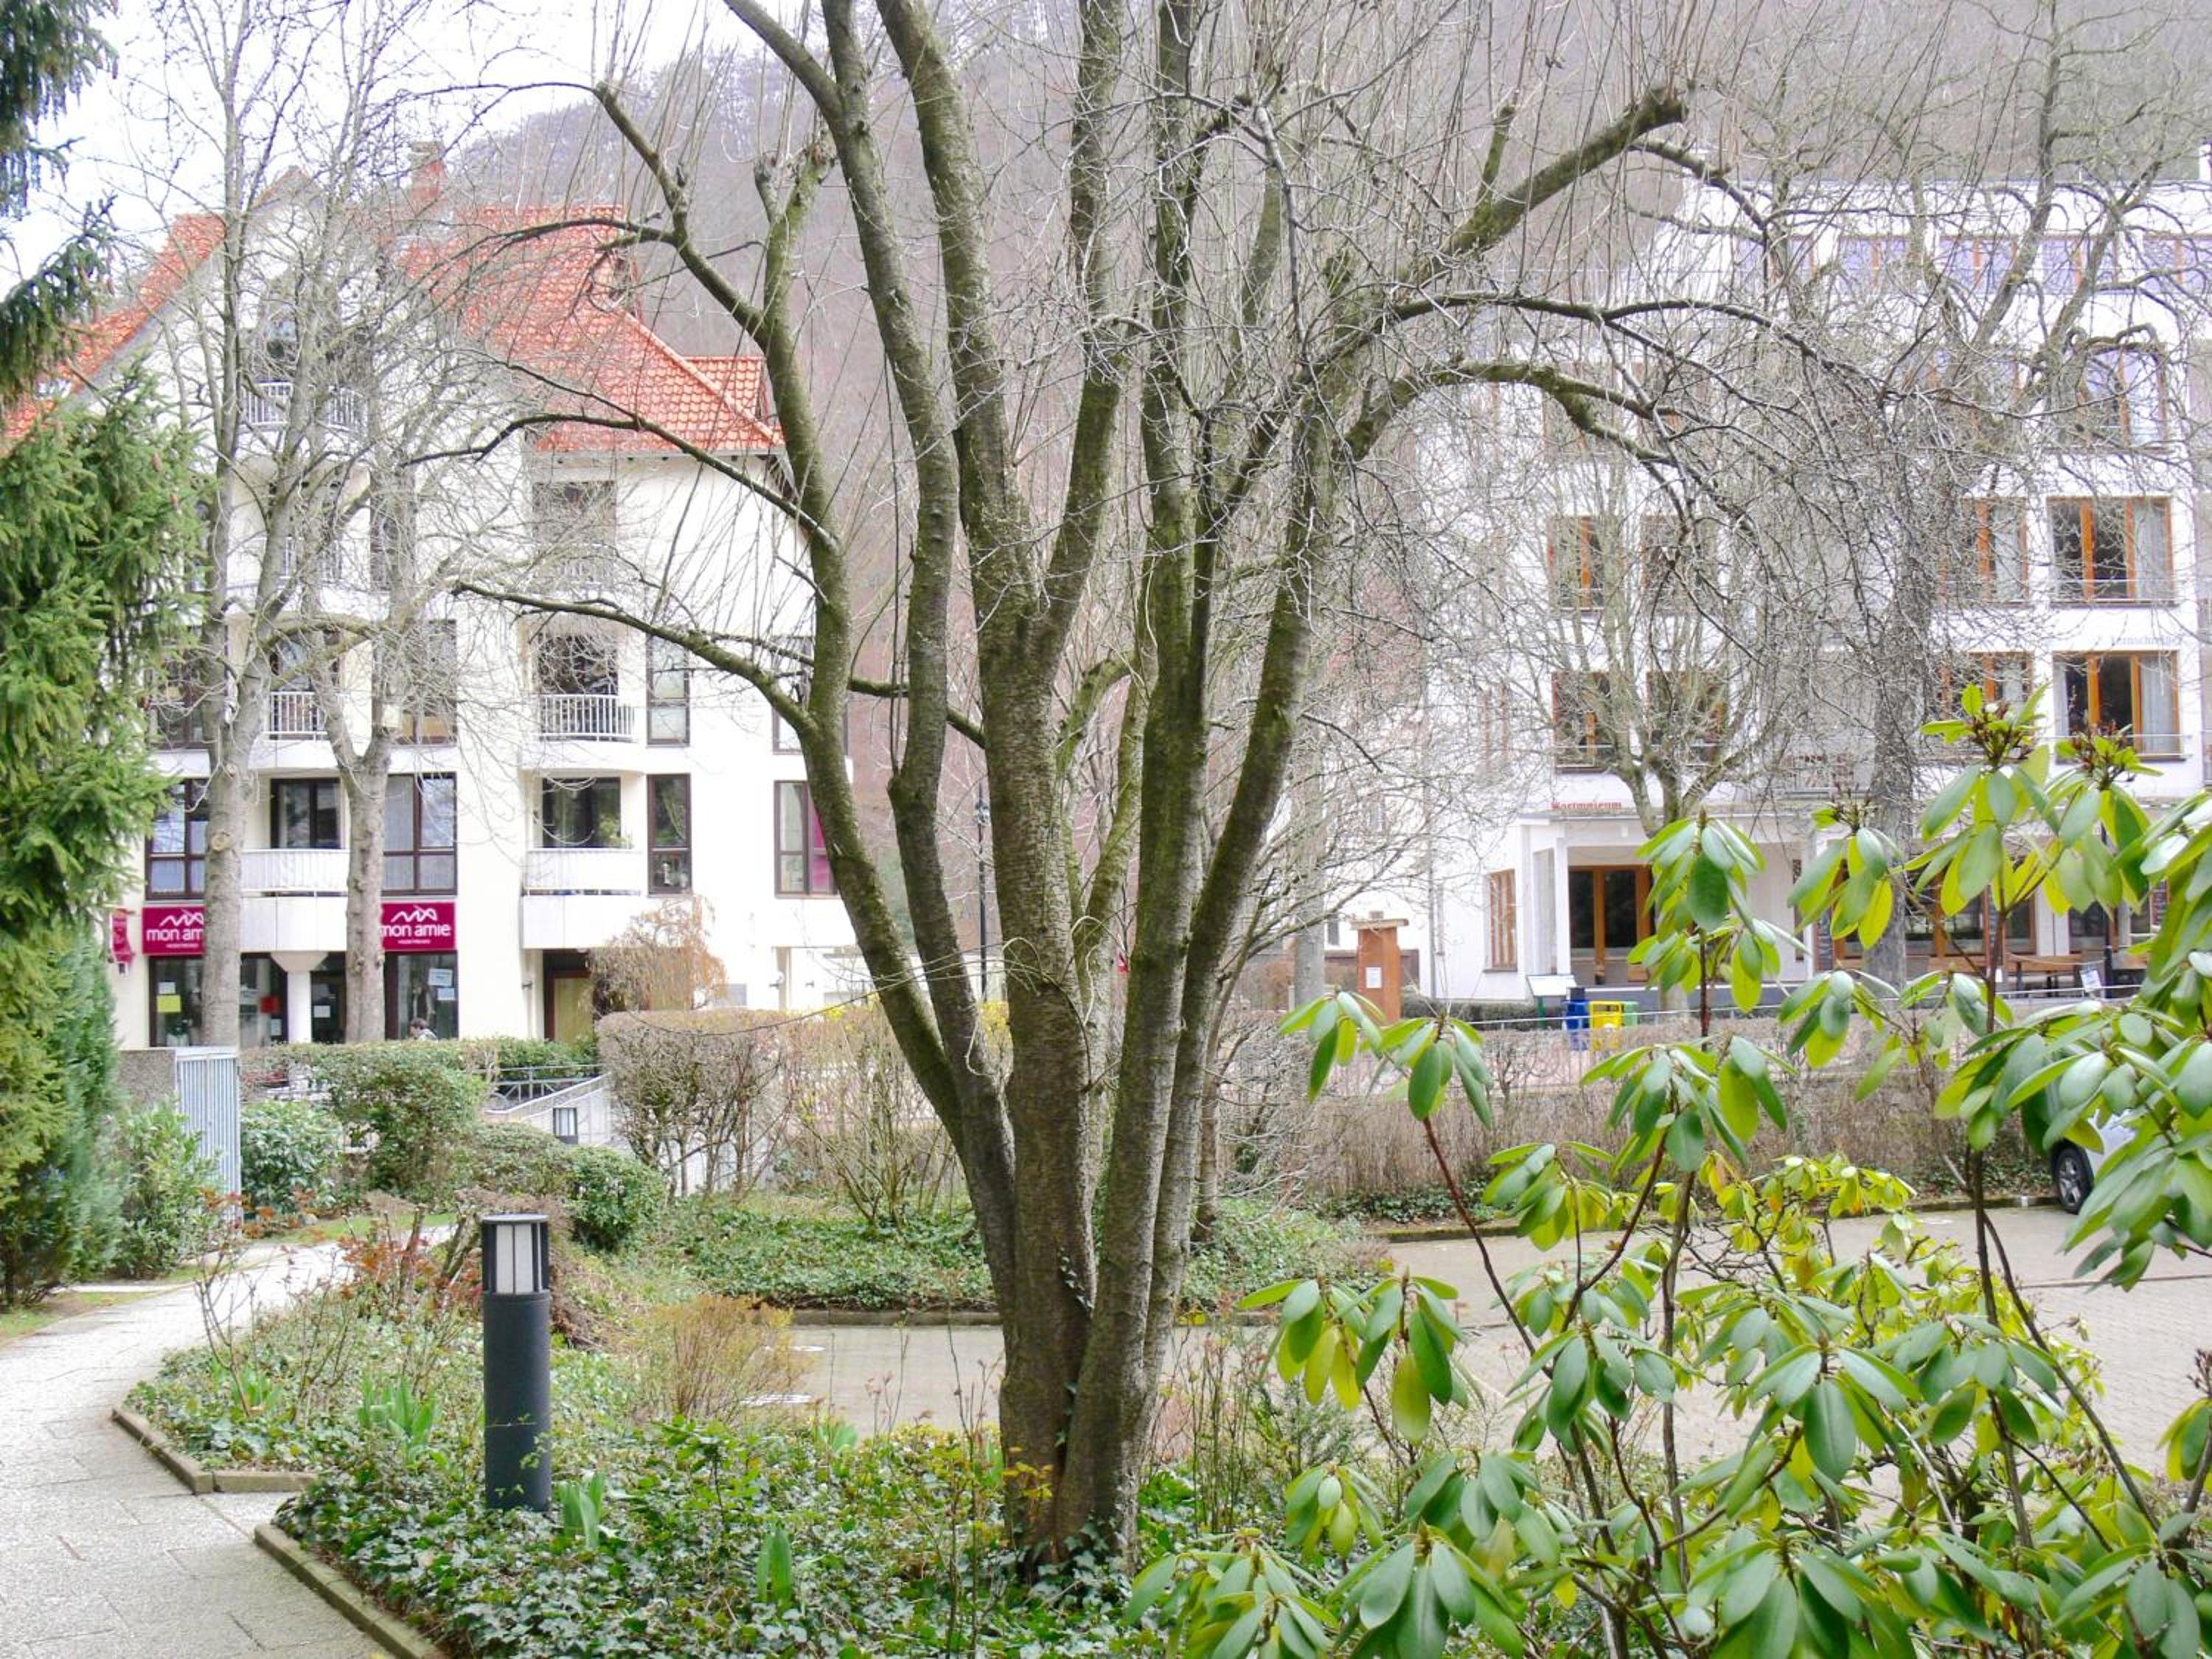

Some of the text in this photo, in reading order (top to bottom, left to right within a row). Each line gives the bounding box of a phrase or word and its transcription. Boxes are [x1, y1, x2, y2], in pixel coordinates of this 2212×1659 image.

[146, 928, 204, 941] mon am
[378, 924, 451, 937] mon amie
